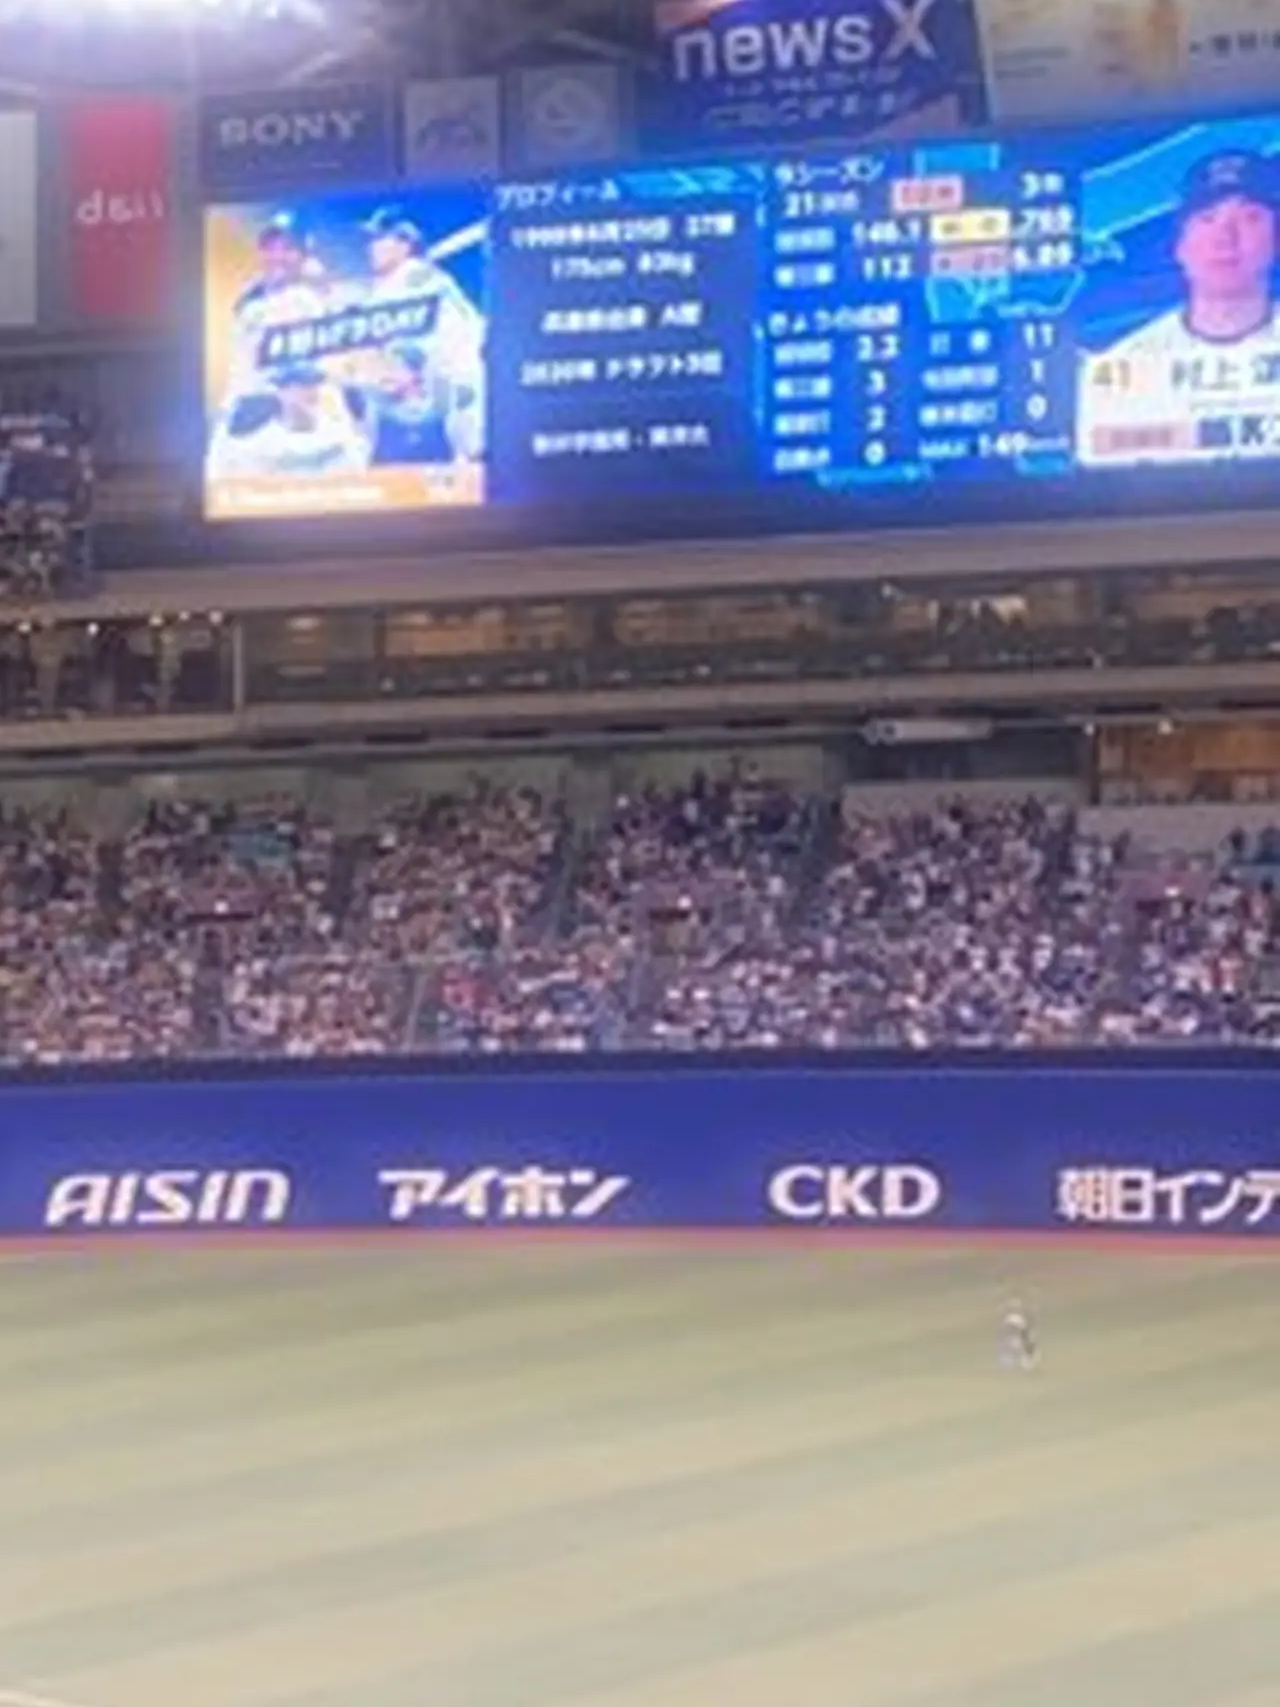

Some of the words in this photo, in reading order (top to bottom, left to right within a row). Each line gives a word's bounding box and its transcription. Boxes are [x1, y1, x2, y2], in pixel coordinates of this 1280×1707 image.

[220, 107, 364, 147] SONY
[44, 1168, 291, 1226] AISIN
[378, 1166, 630, 1219] アイホン
[768, 1164, 940, 1219] CKD
